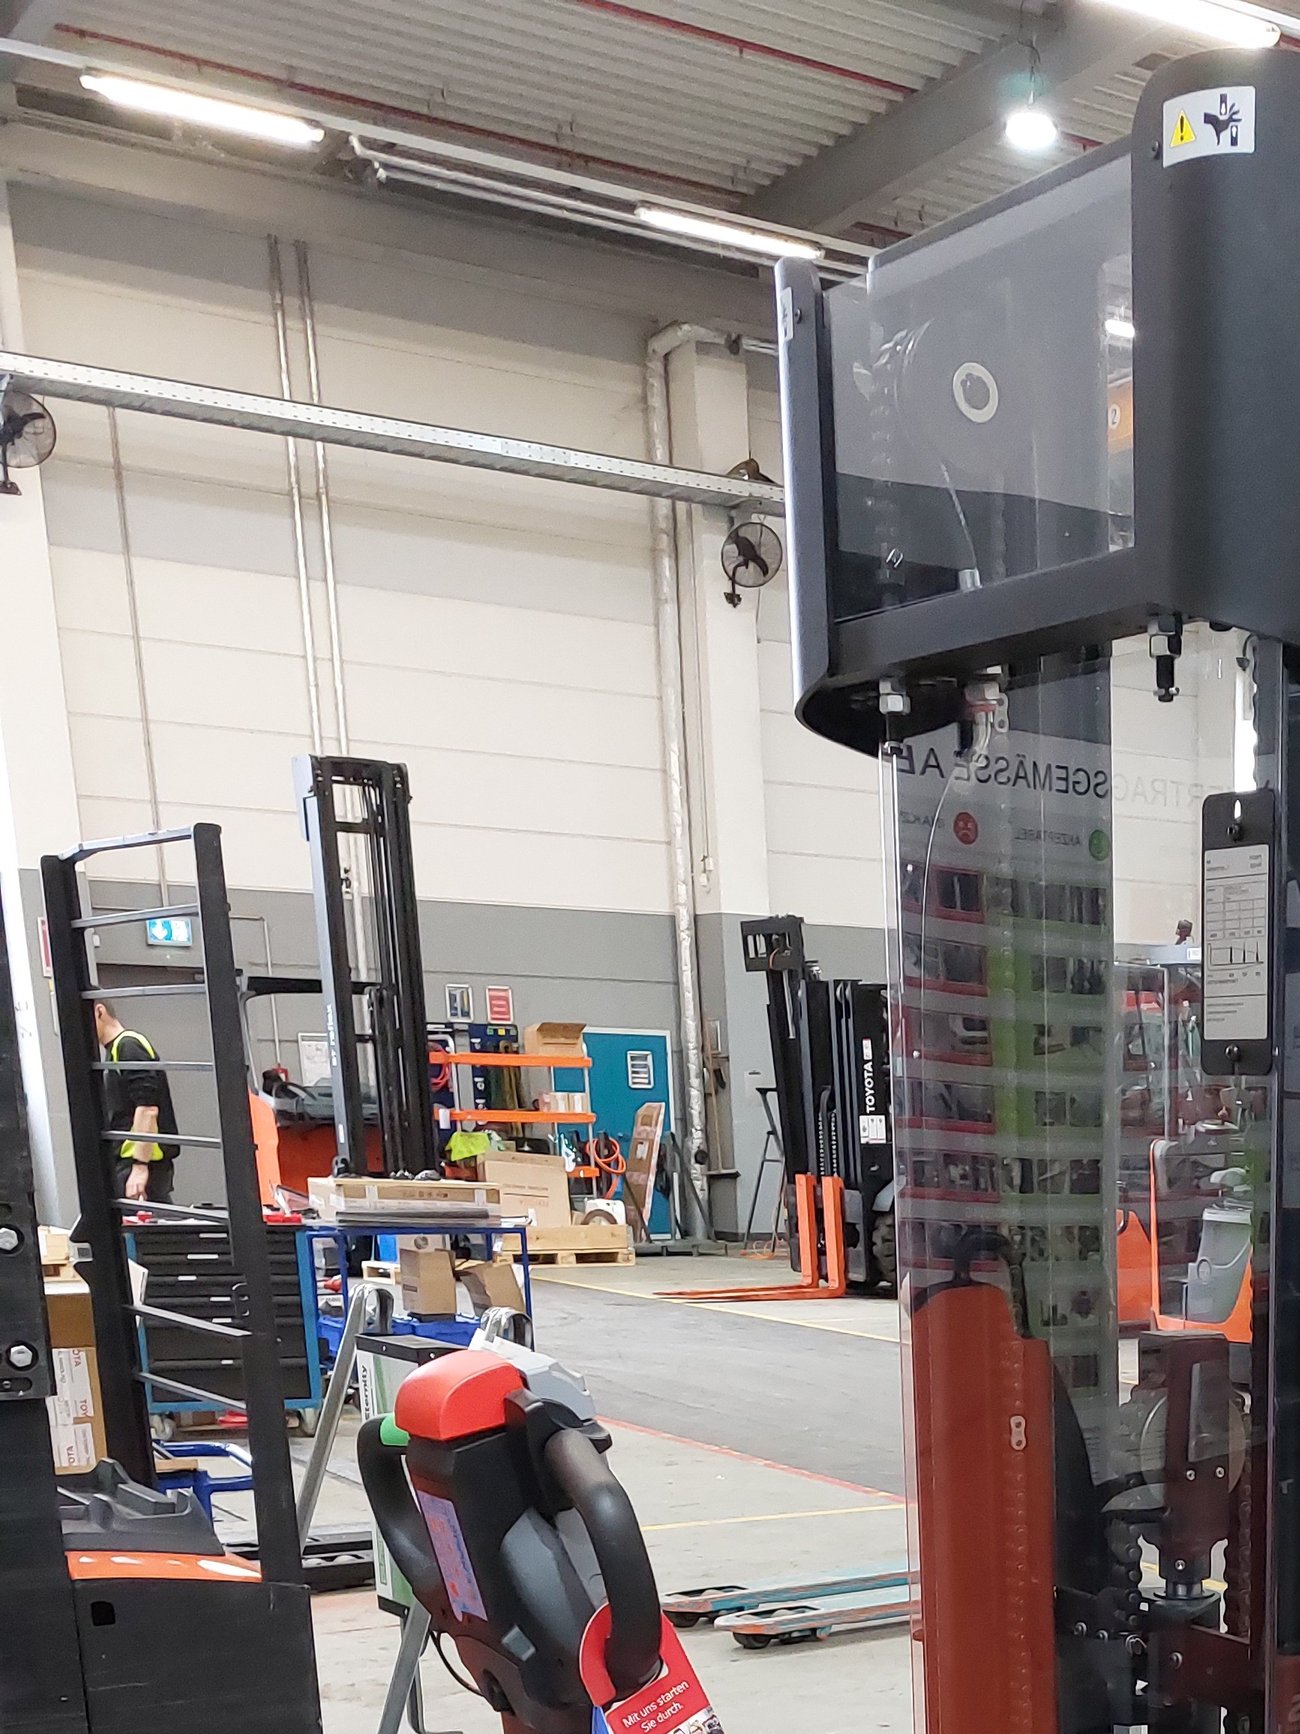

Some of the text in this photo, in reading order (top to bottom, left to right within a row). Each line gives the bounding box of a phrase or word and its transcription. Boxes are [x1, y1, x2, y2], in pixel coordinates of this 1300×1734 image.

[1111, 409, 1117, 425] 2
[863, 1062, 876, 1114] TOYOTA
[363, 1365, 372, 1420] Eternity
[622, 1681, 689, 1728] Mit uns starten
[640, 1701, 684, 1733] Sie durch.
